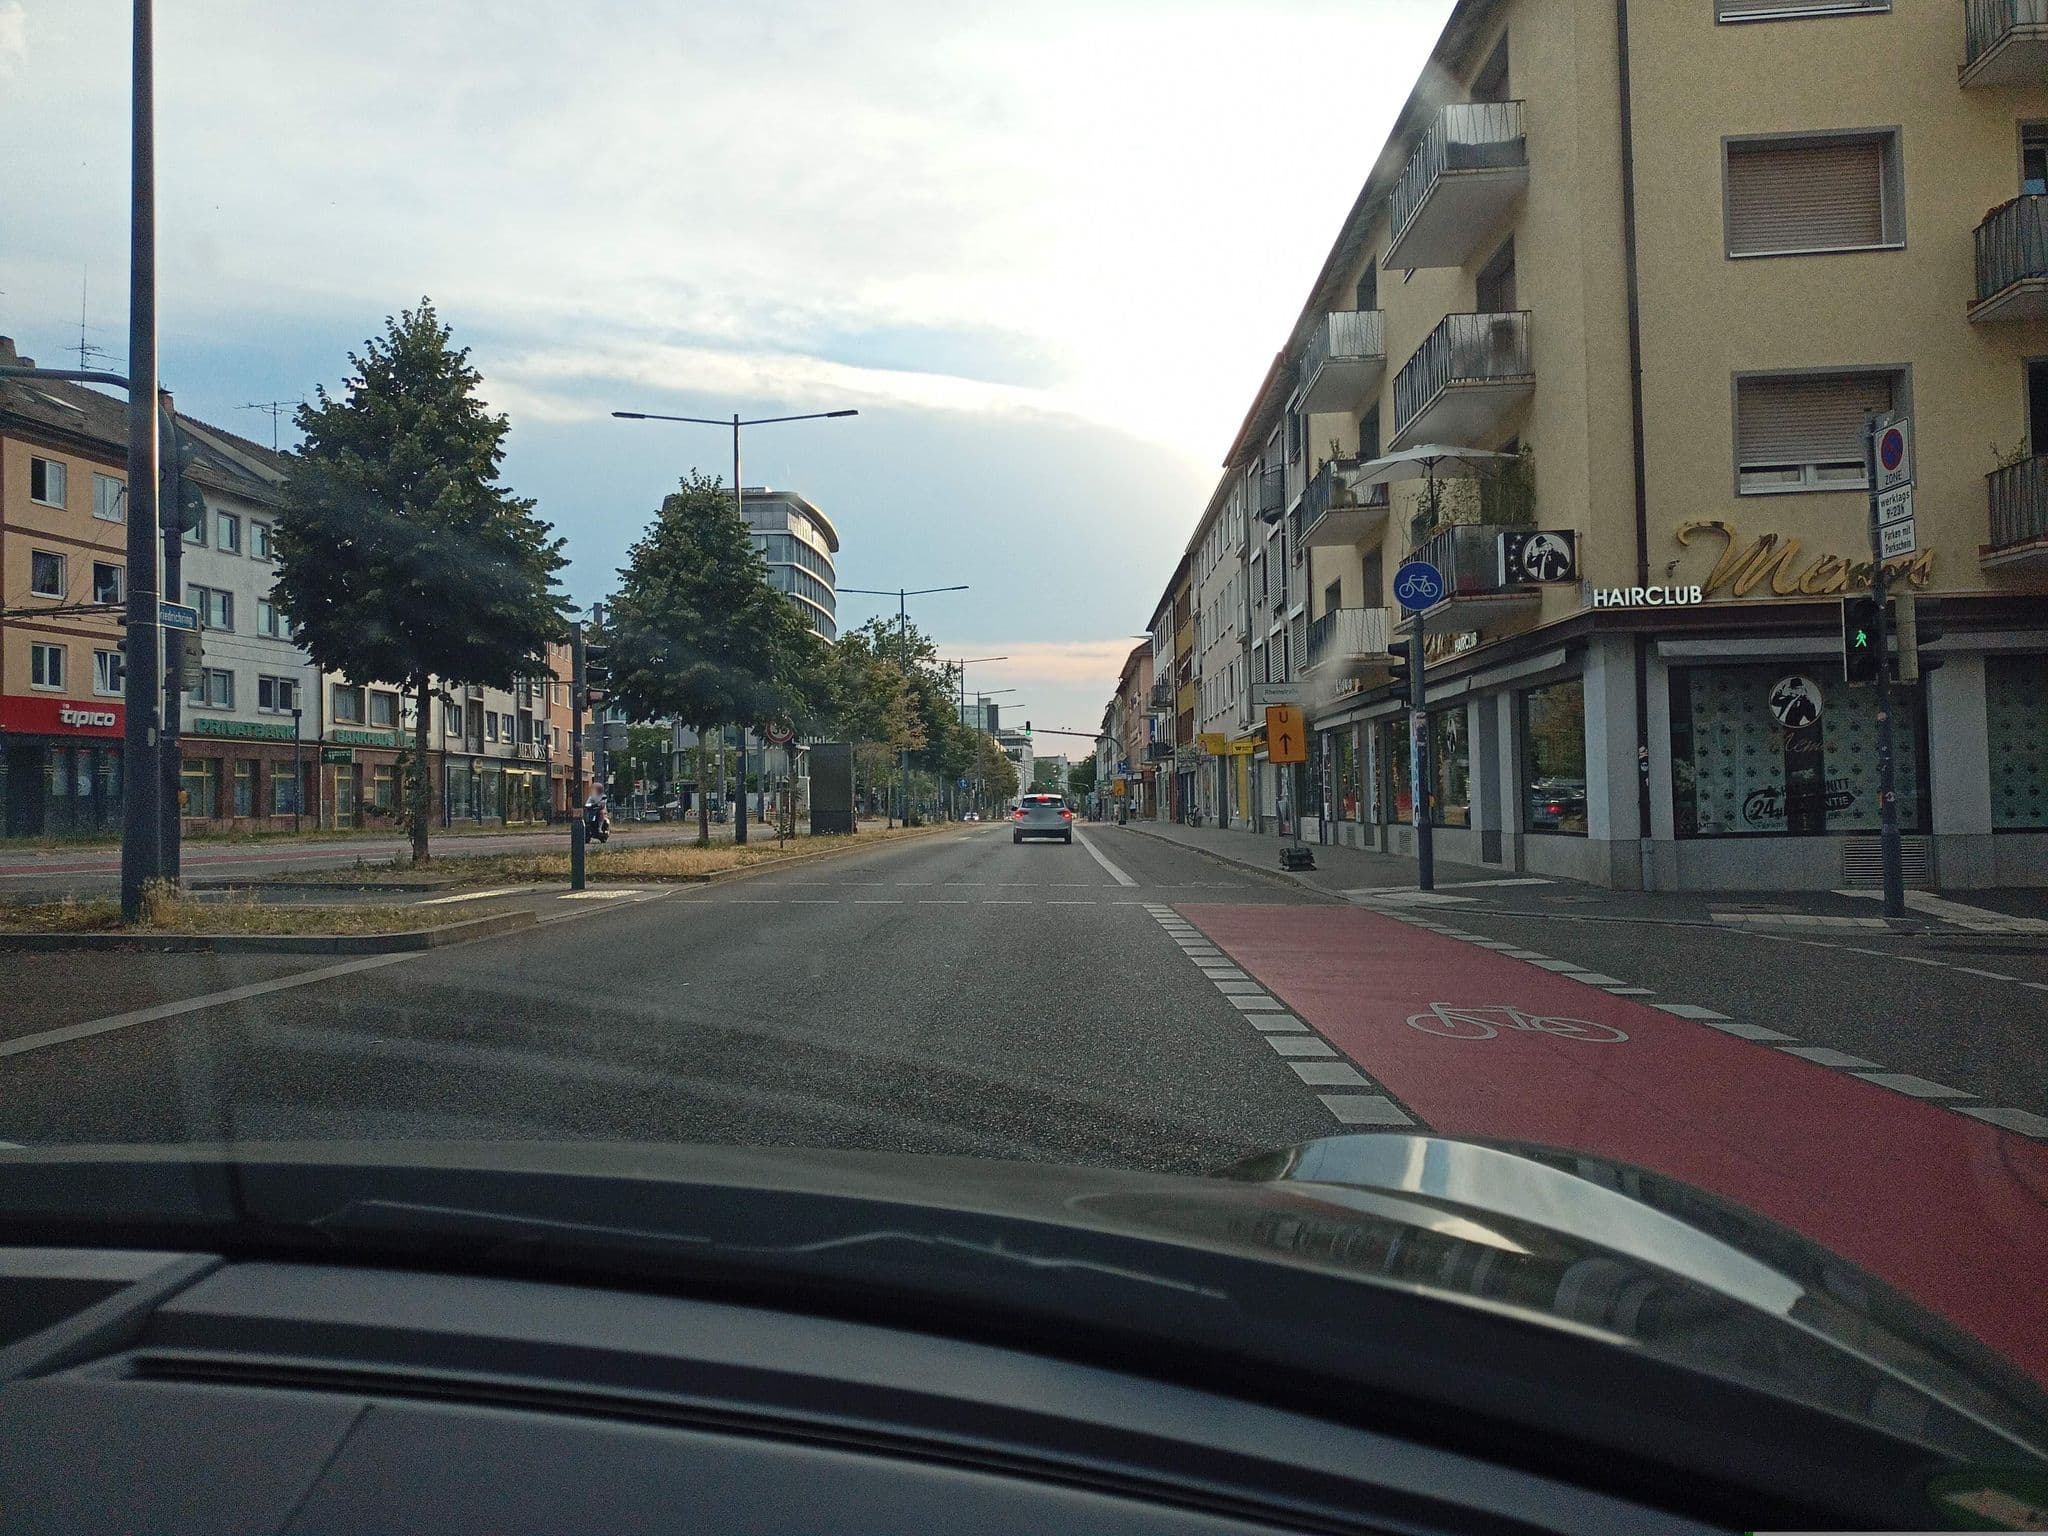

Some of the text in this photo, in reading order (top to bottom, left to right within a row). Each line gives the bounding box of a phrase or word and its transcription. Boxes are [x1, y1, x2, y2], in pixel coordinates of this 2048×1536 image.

[1885, 470, 1903, 485] ZONE
[1881, 491, 1910, 507] werktags
[1884, 529, 1901, 541] Parken
[1593, 585, 1703, 607] HAIRCLUB
[59, 703, 116, 728] tipico
[1279, 711, 1289, 724] U
[197, 719, 296, 739] PRIVATBANK
